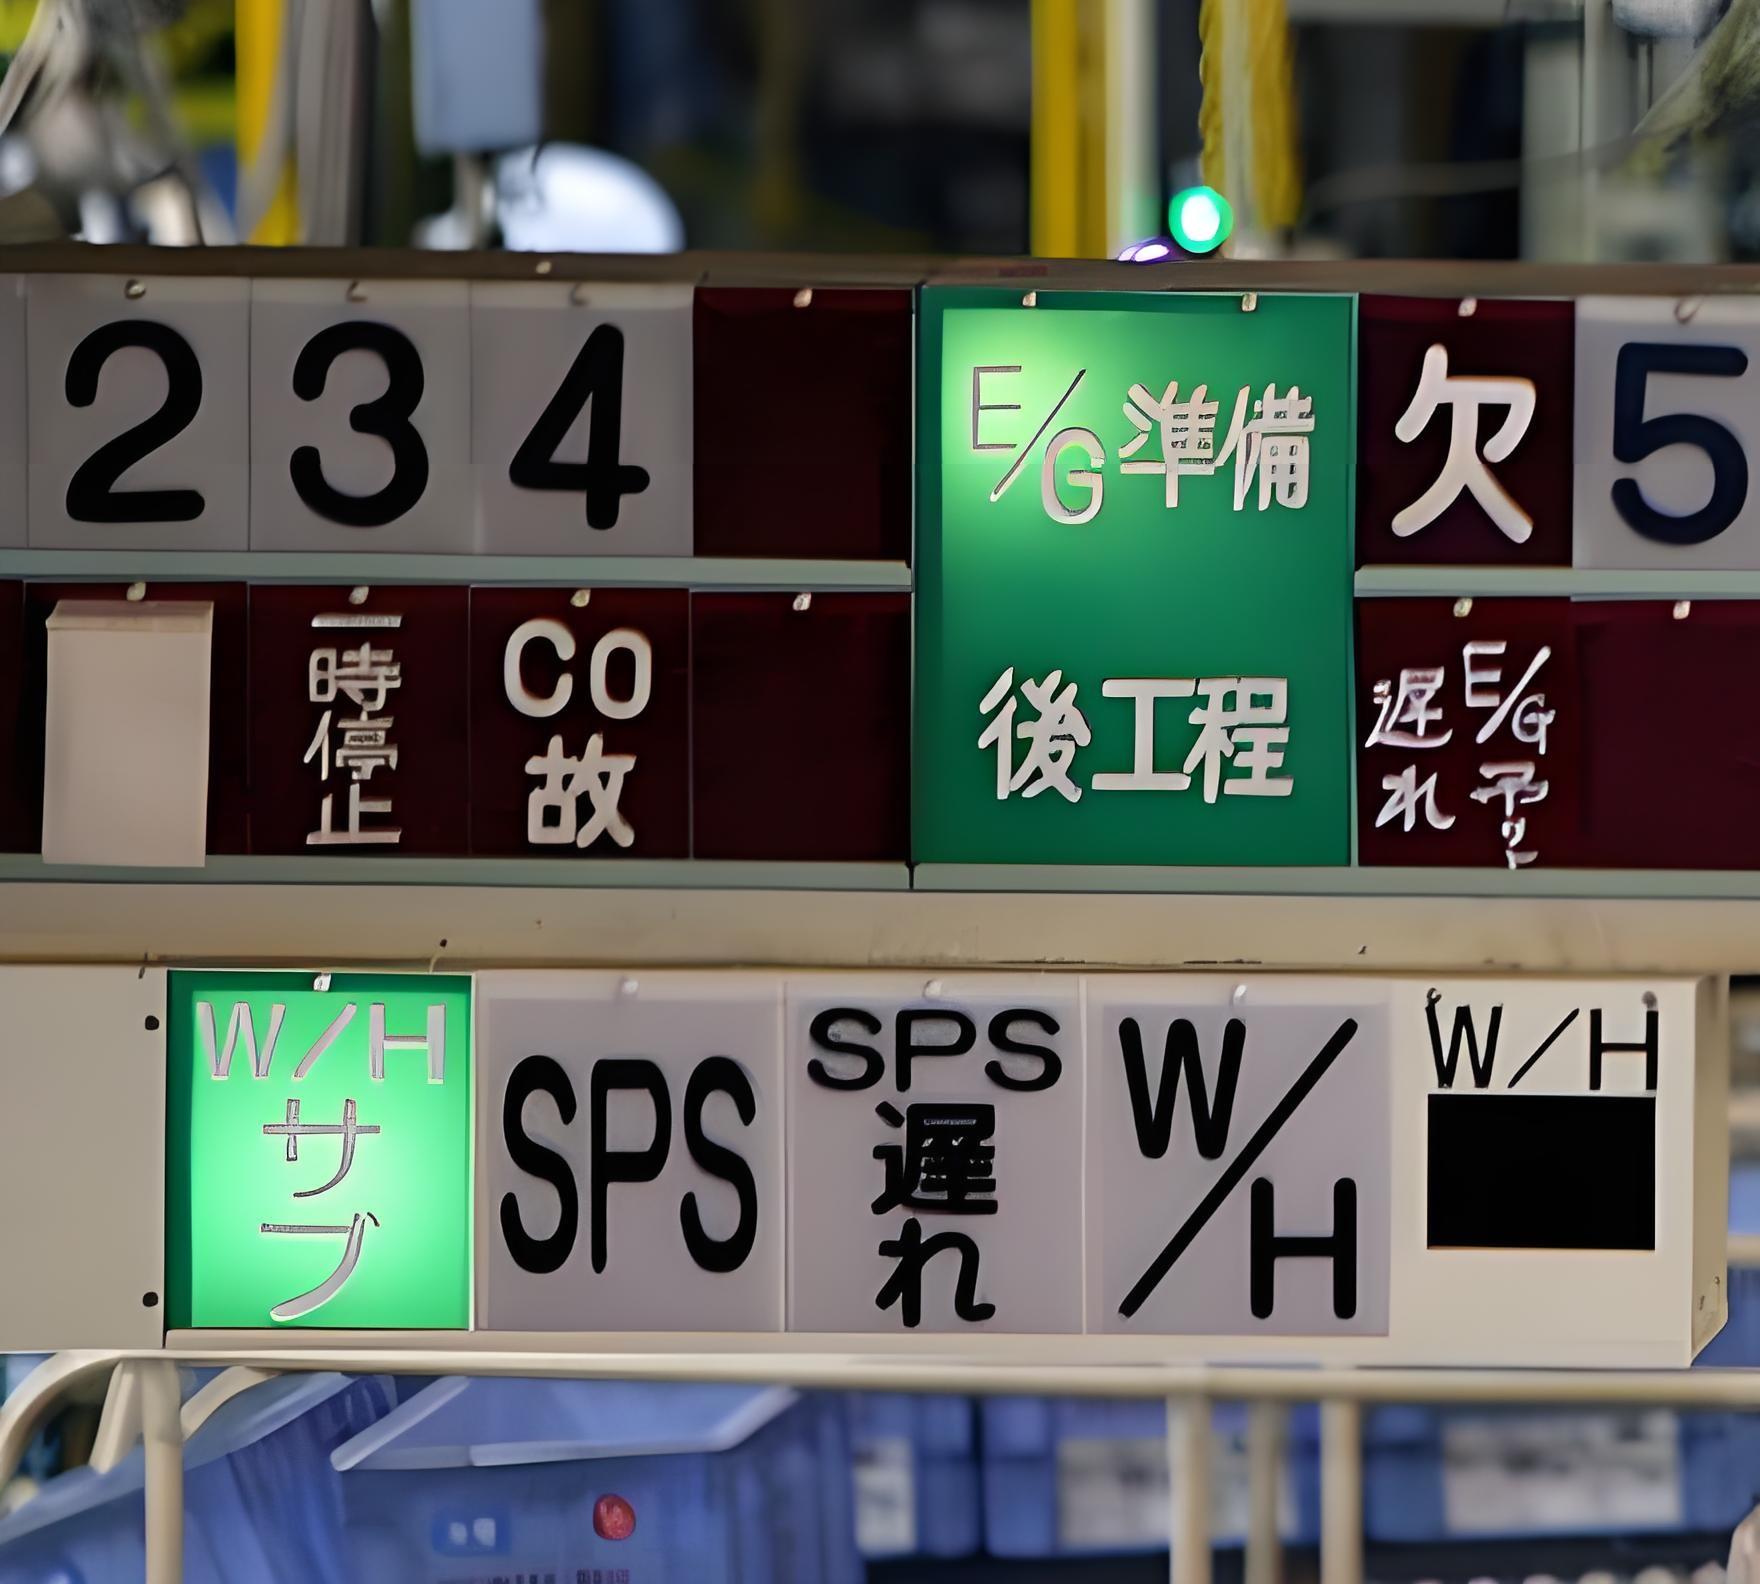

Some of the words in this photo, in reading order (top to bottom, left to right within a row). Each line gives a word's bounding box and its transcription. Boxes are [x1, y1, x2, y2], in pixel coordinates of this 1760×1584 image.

[64, 319, 206, 523] 2
[289, 321, 430, 527] 3
[508, 323, 651, 530] 4
[1391, 342, 1537, 544] 欠
[1611, 342, 1749, 545] 5
[525, 734, 637, 849] 故
[977, 665, 1295, 804] 後工程
[196, 1001, 447, 1084] W/H
[806, 1006, 1063, 1092] SPS
[1426, 1002, 1660, 1090] W/H
[499, 1053, 759, 1276] SPS
[1117, 1016, 1360, 1321] W/H
